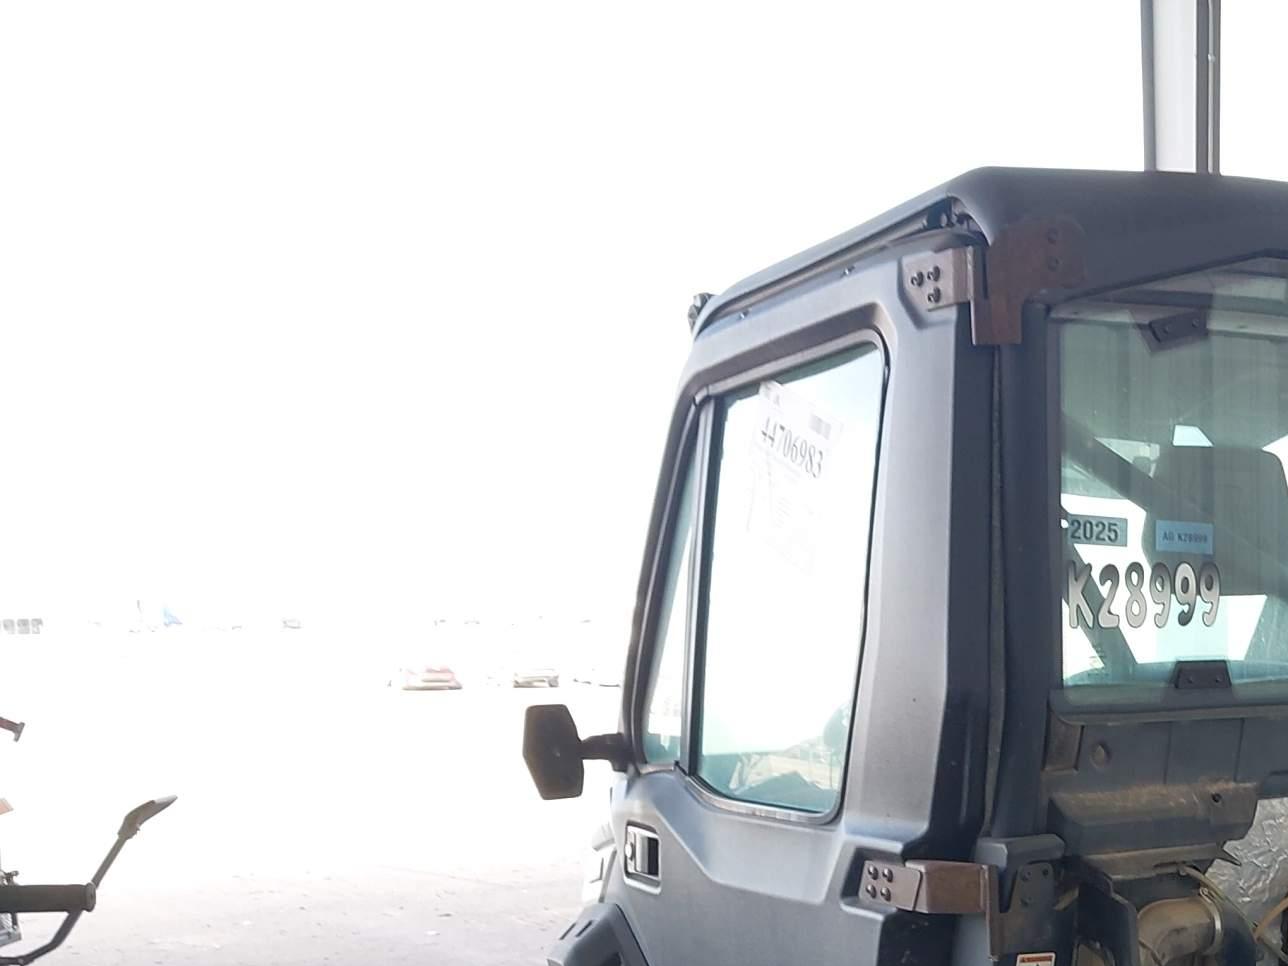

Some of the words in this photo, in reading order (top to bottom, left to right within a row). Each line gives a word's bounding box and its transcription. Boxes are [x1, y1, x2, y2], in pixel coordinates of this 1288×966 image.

[761, 416, 823, 479] 44706983
[1070, 519, 1119, 543] 2025
[1067, 560, 1221, 628] K28999
